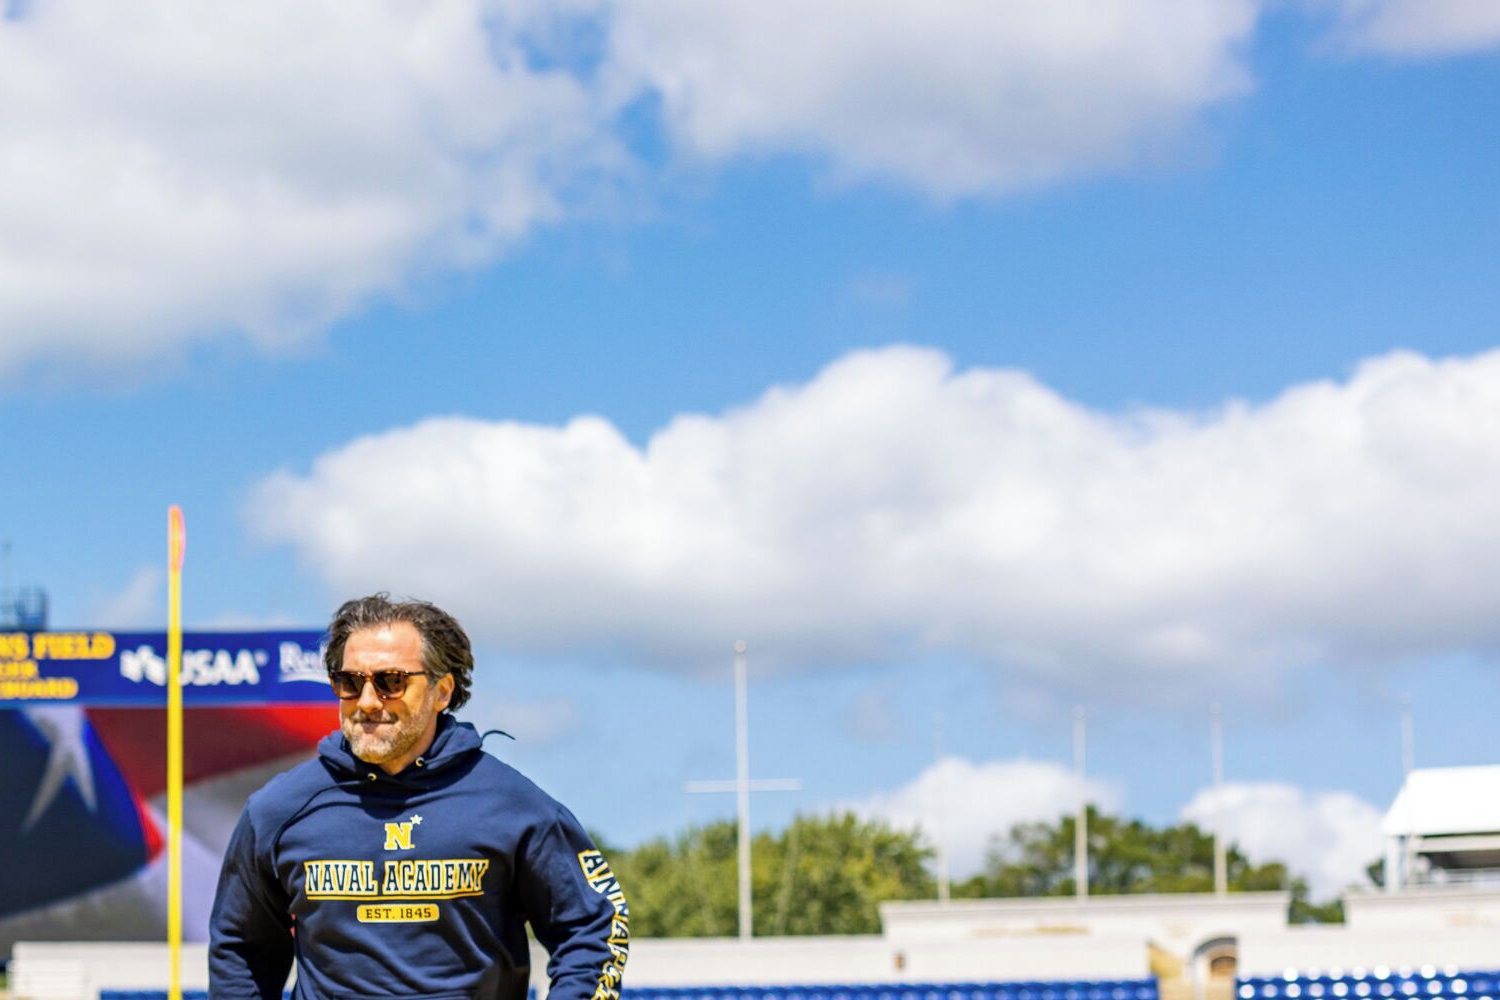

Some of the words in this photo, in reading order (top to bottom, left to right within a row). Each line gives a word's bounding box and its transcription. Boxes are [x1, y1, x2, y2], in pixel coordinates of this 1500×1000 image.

[33, 632, 116, 660] FIELD
[383, 822, 414, 851] N
[304, 860, 378, 896] NAVAL
[382, 858, 489, 896] ACADEMY
[365, 907, 396, 920] EST.
[400, 906, 432, 920] 1845
